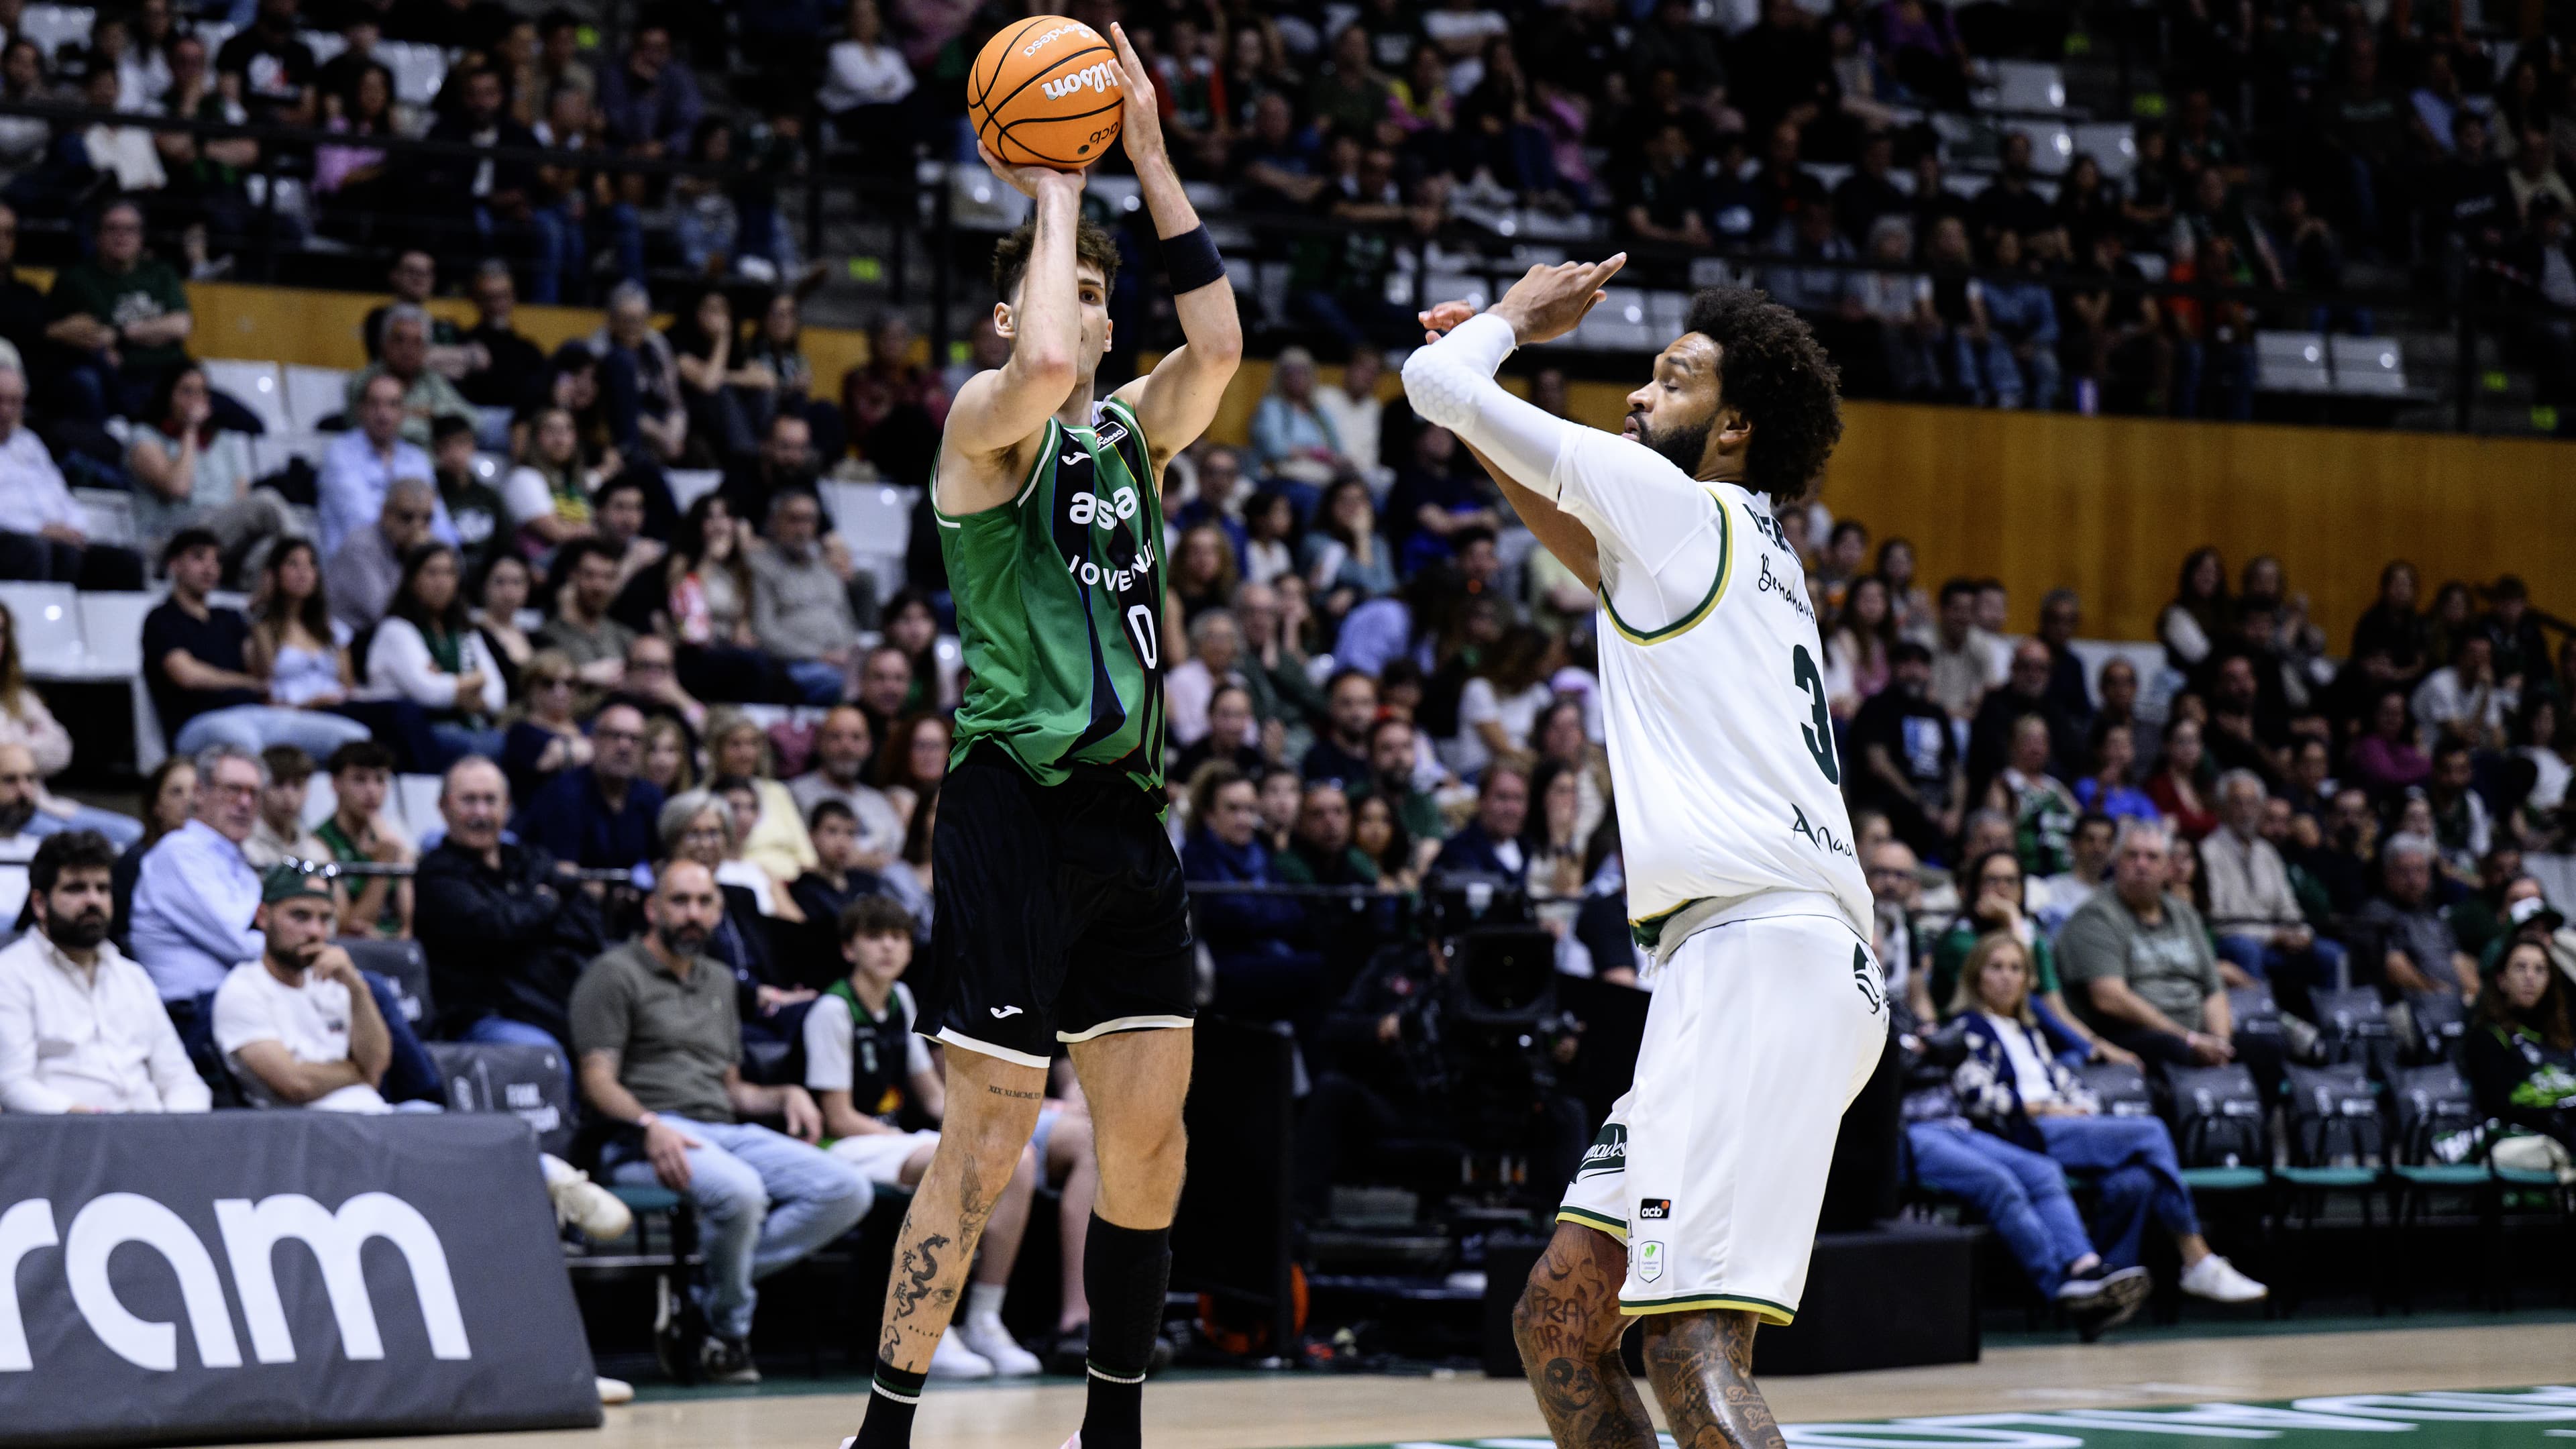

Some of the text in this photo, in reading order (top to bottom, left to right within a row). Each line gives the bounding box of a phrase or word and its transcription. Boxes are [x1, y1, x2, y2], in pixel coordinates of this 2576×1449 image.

[1041, 58, 1119, 100] ilson
[1089, 121, 1118, 144] acb
[1128, 604, 1157, 669] 0
[1793, 644, 1839, 785] 3
[1642, 1205, 1663, 1218] acb
[0, 1192, 472, 1371] ram
